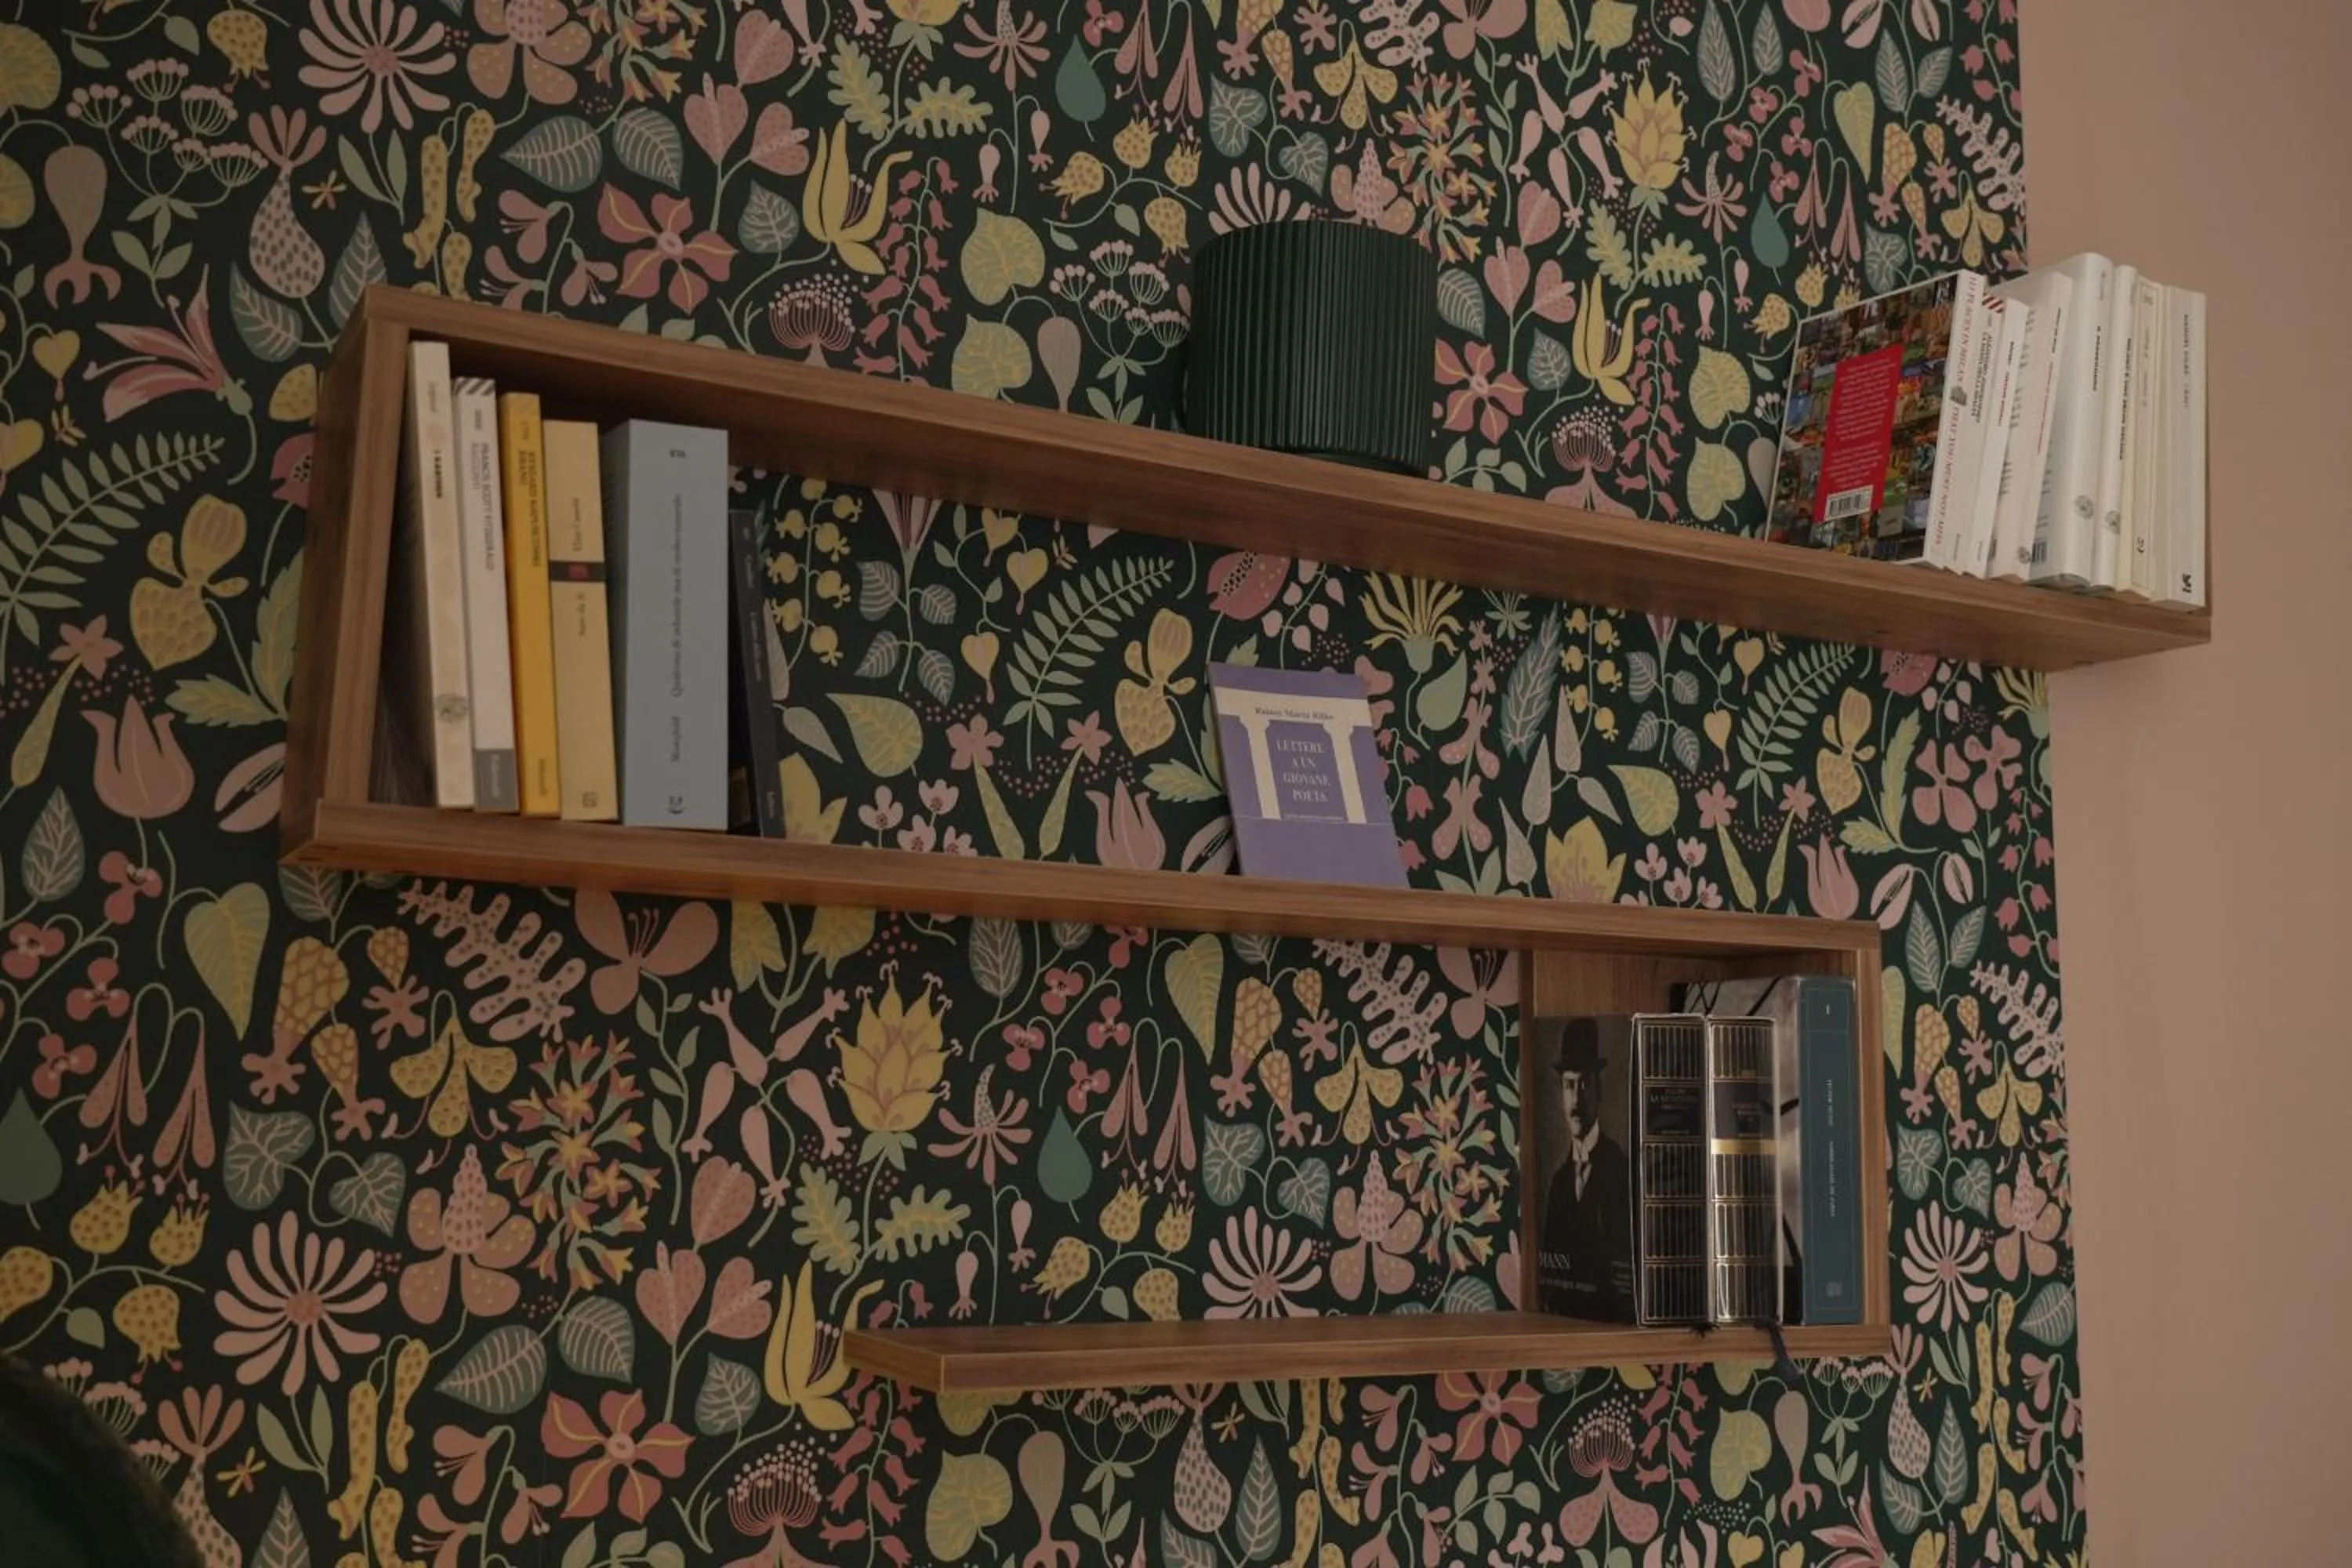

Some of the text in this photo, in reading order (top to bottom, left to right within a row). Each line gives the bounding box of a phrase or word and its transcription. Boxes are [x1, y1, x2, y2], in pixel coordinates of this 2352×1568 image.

[1276, 739, 1326, 753] LETTERE
[1283, 771, 1330, 786] GIOVANE
[1292, 789, 1329, 801] POETA
[1539, 1250, 1571, 1270] MANN
